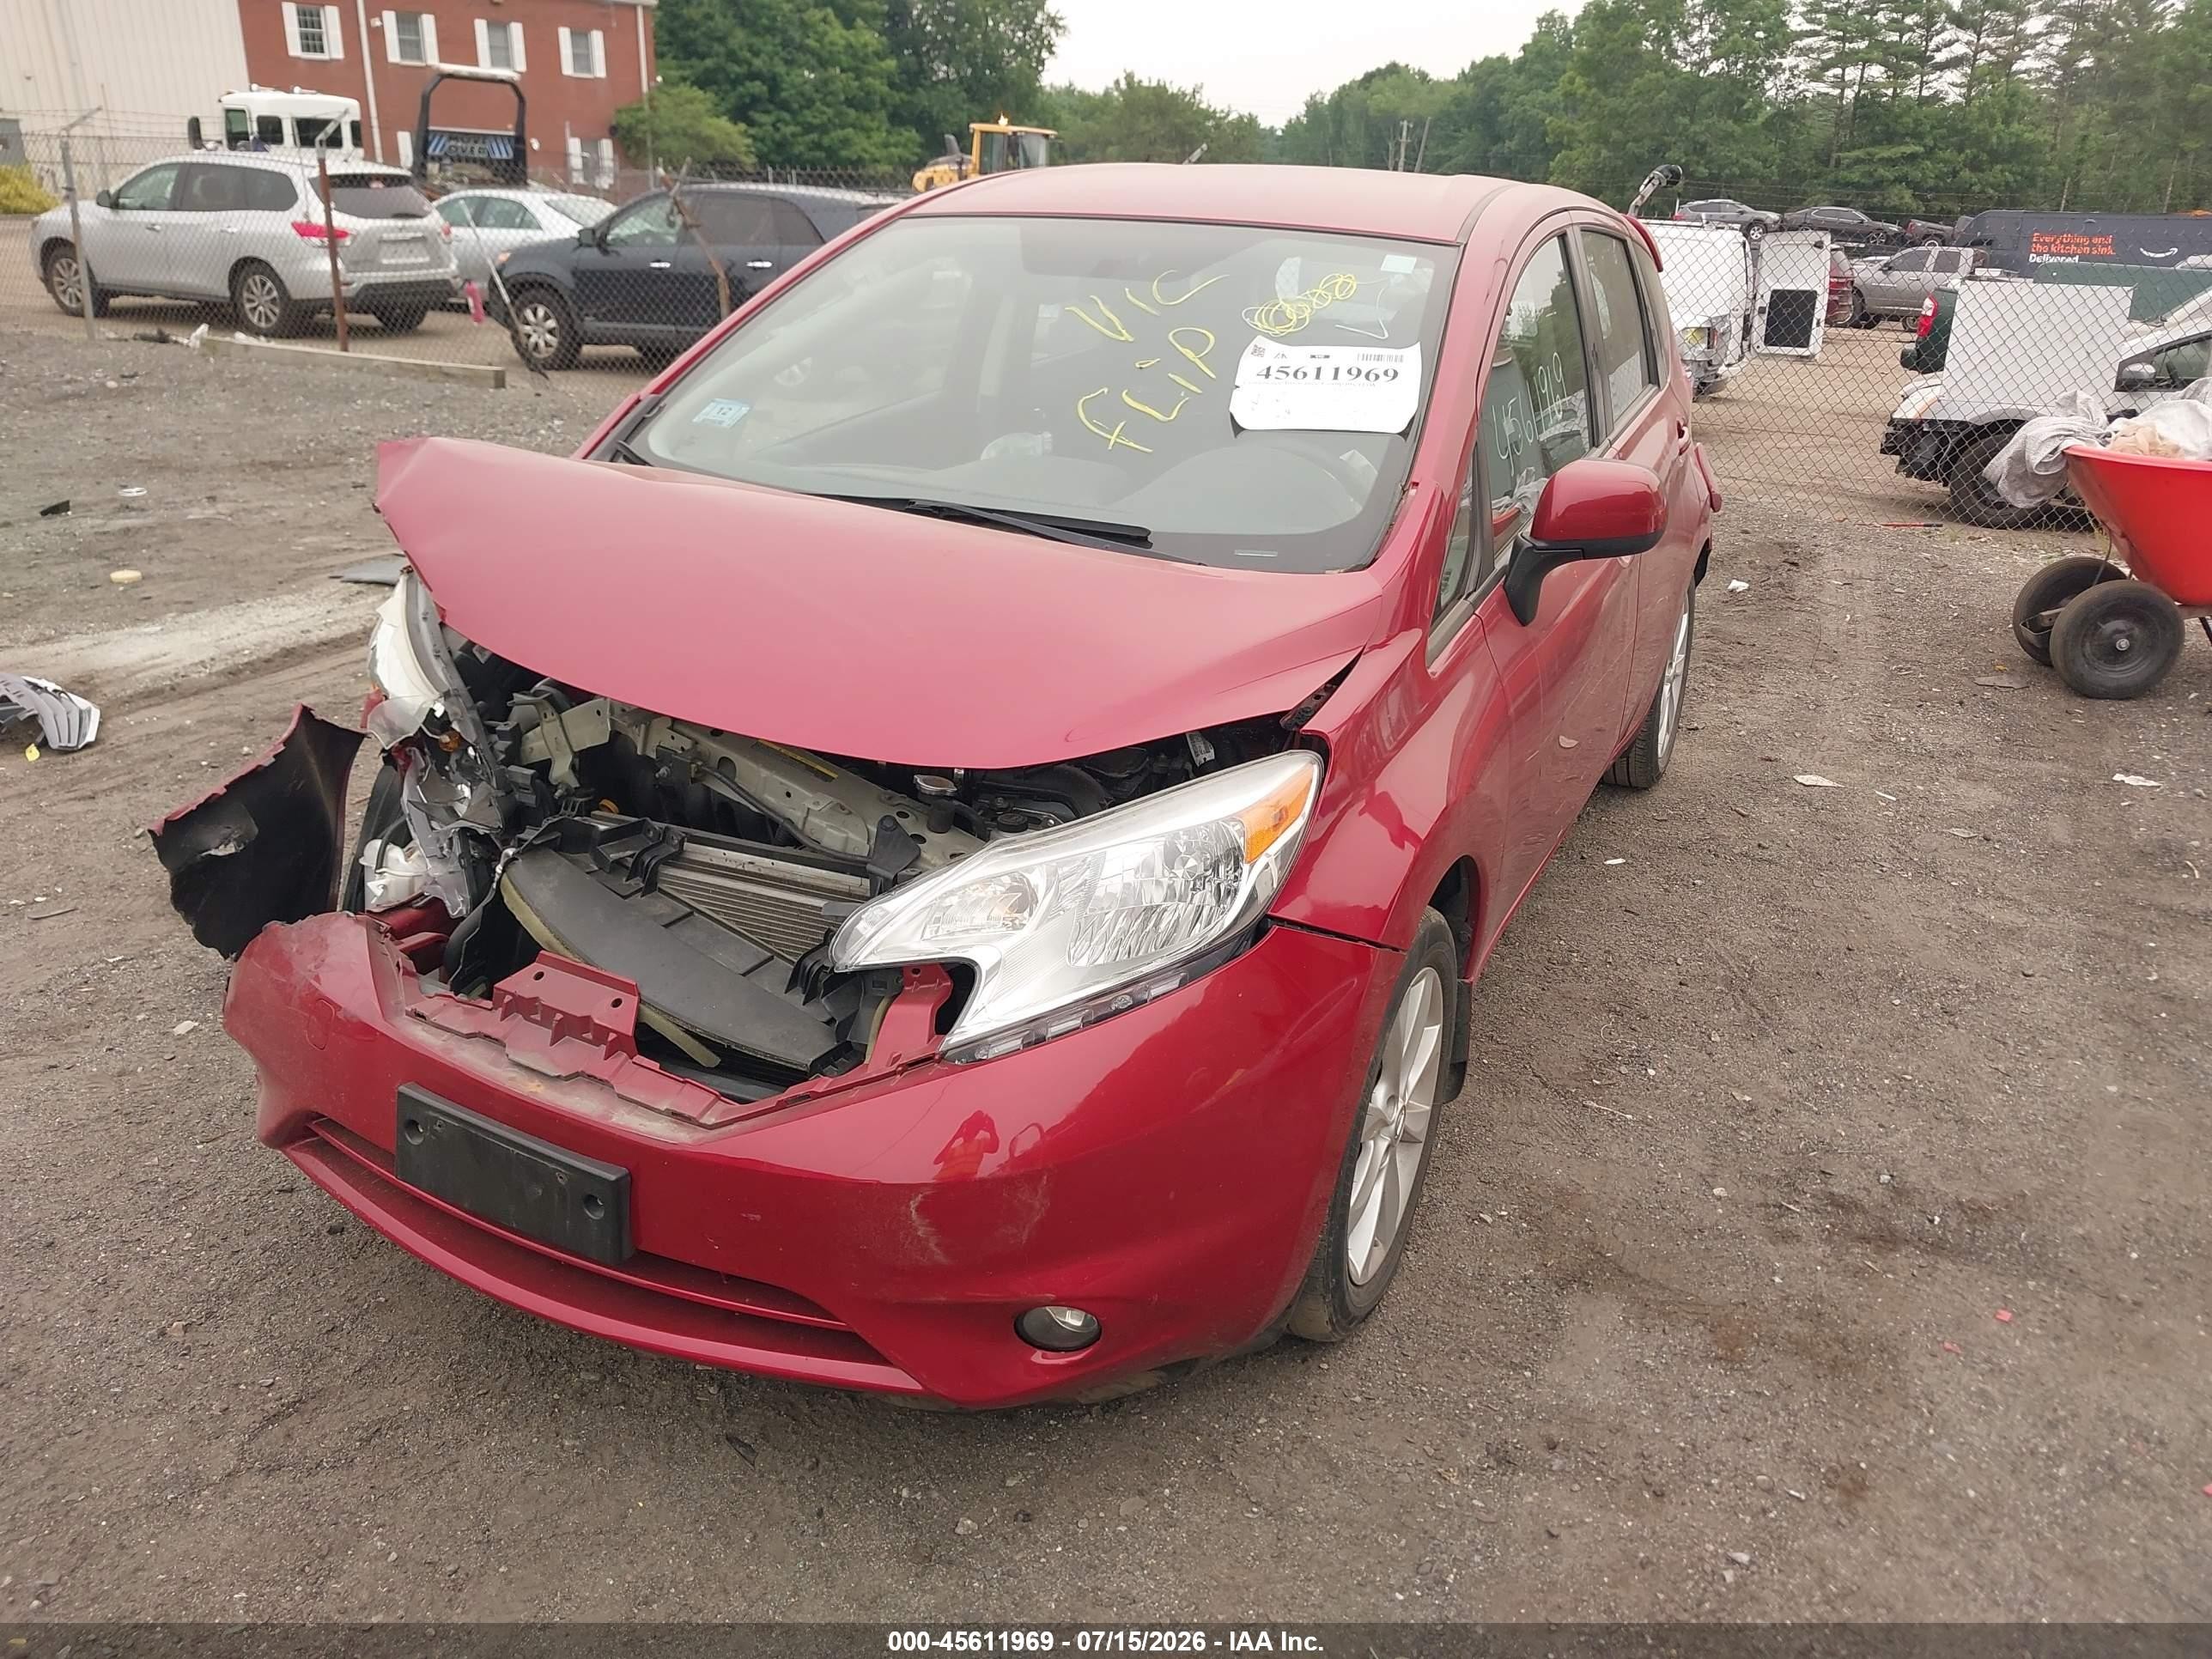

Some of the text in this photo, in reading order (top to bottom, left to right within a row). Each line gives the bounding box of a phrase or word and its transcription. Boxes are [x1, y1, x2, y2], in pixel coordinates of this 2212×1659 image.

[2033, 233, 2113, 246] Everything and
[2032, 243, 2049, 252] the
[2051, 244, 2090, 255] kitchen
[1065, 270, 1230, 342] VIC
[1255, 365, 1400, 383] 45611969
[1492, 351, 1569, 477] 45611969
